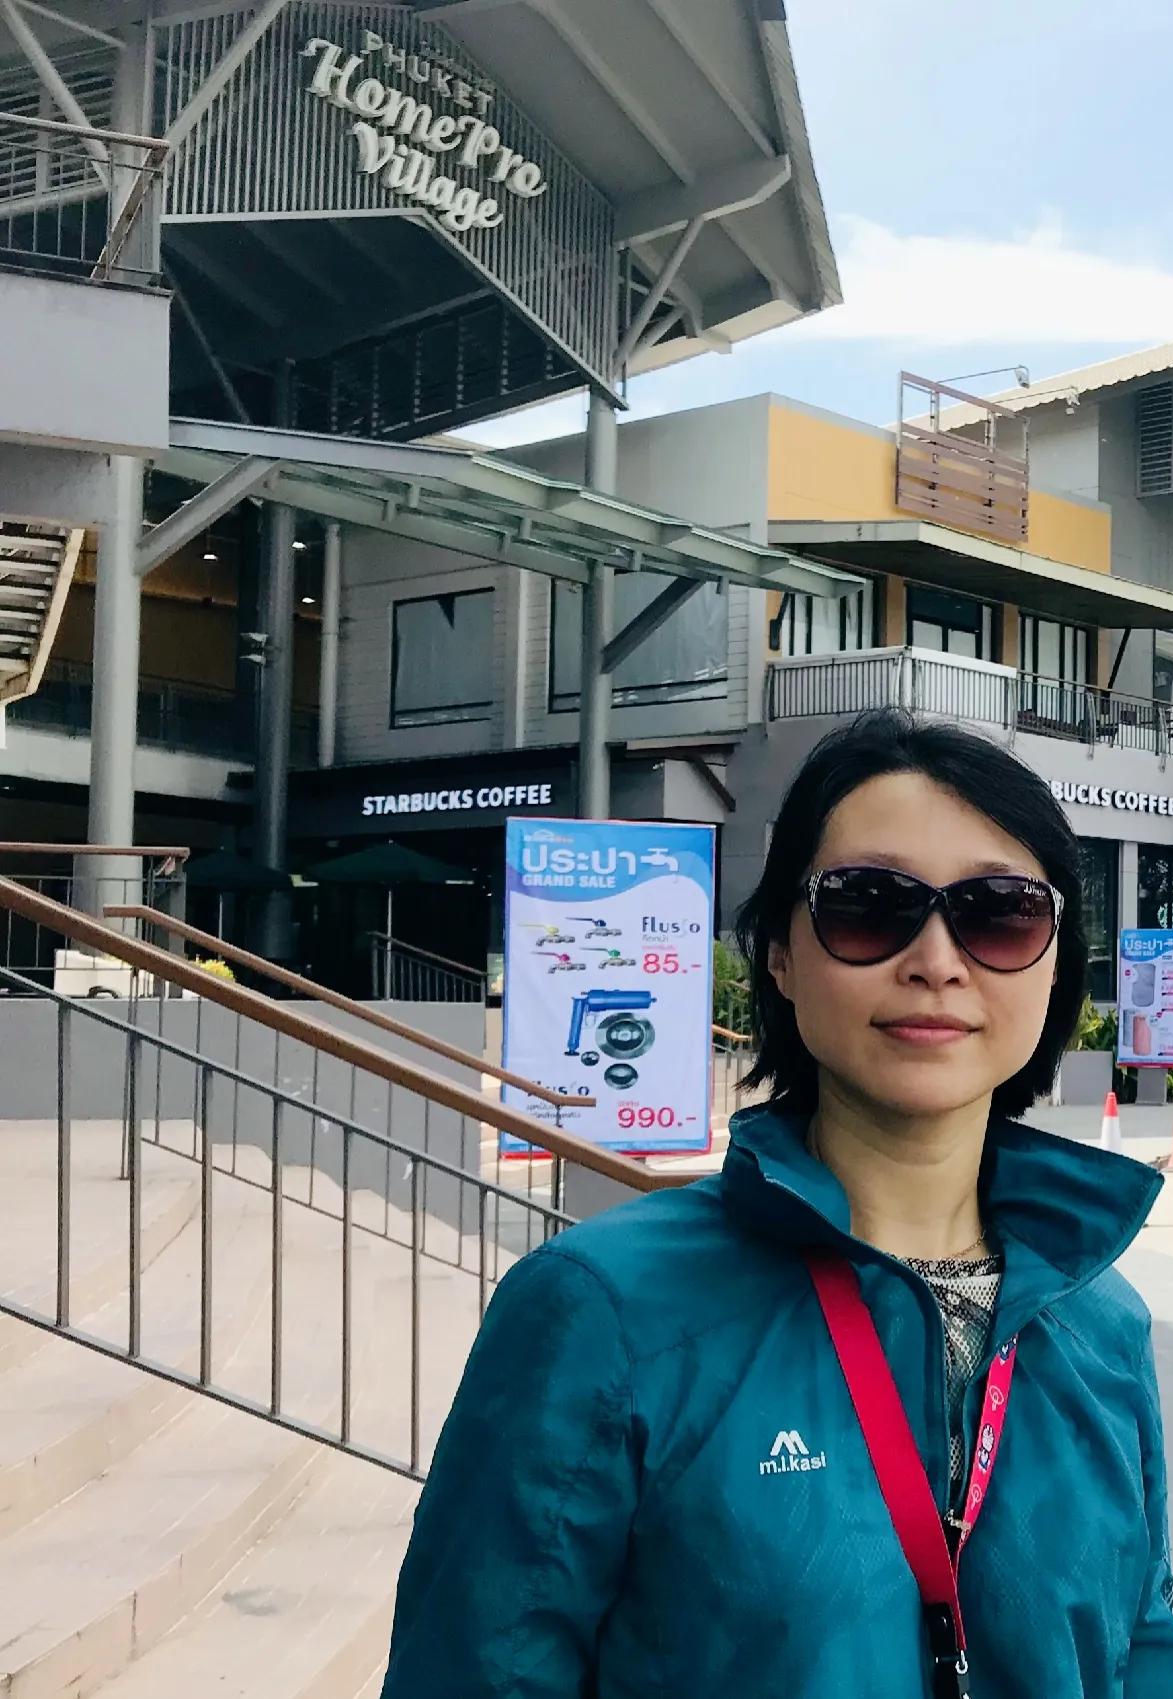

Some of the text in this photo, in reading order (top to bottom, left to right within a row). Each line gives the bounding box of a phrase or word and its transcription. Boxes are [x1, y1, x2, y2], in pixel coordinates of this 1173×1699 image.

[361, 29, 496, 115] PHUKET
[350, 121, 504, 231] Village
[362, 784, 552, 816] STARBUCKS COFFEE
[1042, 778, 1112, 807] BUCKS
[522, 844, 637, 876] ประปา
[522, 874, 617, 888] GRAND SALE
